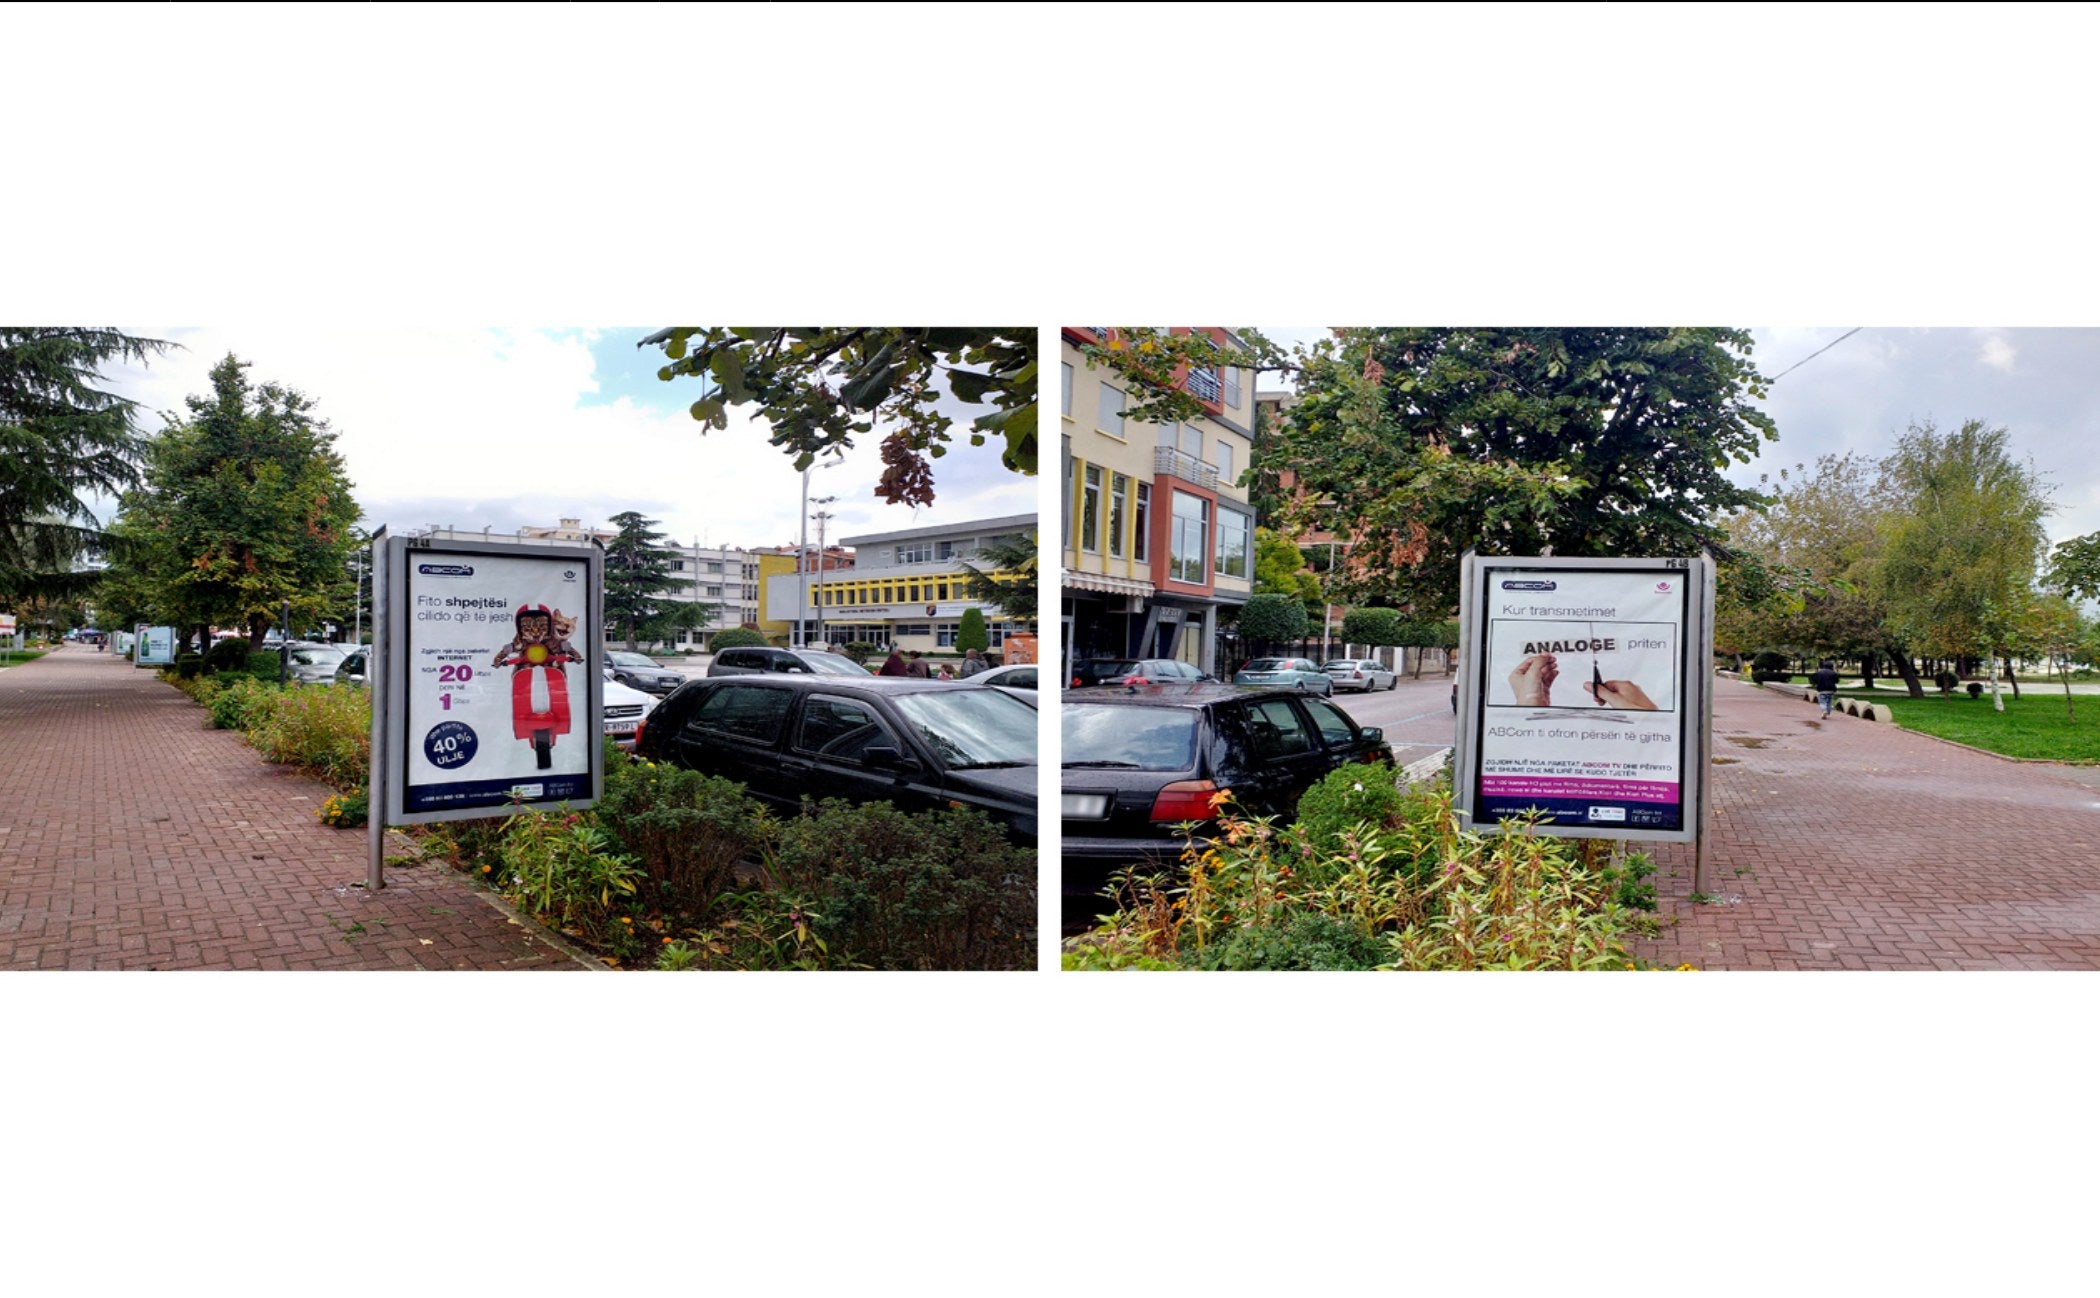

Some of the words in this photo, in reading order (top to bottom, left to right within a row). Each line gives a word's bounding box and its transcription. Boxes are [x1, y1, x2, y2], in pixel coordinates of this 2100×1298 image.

[417, 595, 442, 607] Fito
[445, 597, 507, 609] shpejtësi
[417, 611, 452, 622] cilido
[455, 612, 470, 624] që
[474, 611, 485, 622] të
[489, 612, 514, 624] jesh
[1503, 605, 1527, 615] Kur
[1530, 606, 1616, 617] transmetimet
[1523, 638, 1616, 655] ANALOGE
[1627, 638, 1667, 650] priten
[439, 664, 473, 682] 20
[439, 693, 451, 710] 1
[433, 732, 472, 753] 40%
[1488, 727, 1534, 737] ABCom
[1538, 728, 1545, 737] ti
[1548, 728, 1579, 738] ofron
[1625, 730, 1637, 741] të
[1640, 731, 1672, 743] gjitha
[437, 751, 464, 764] ULJE
